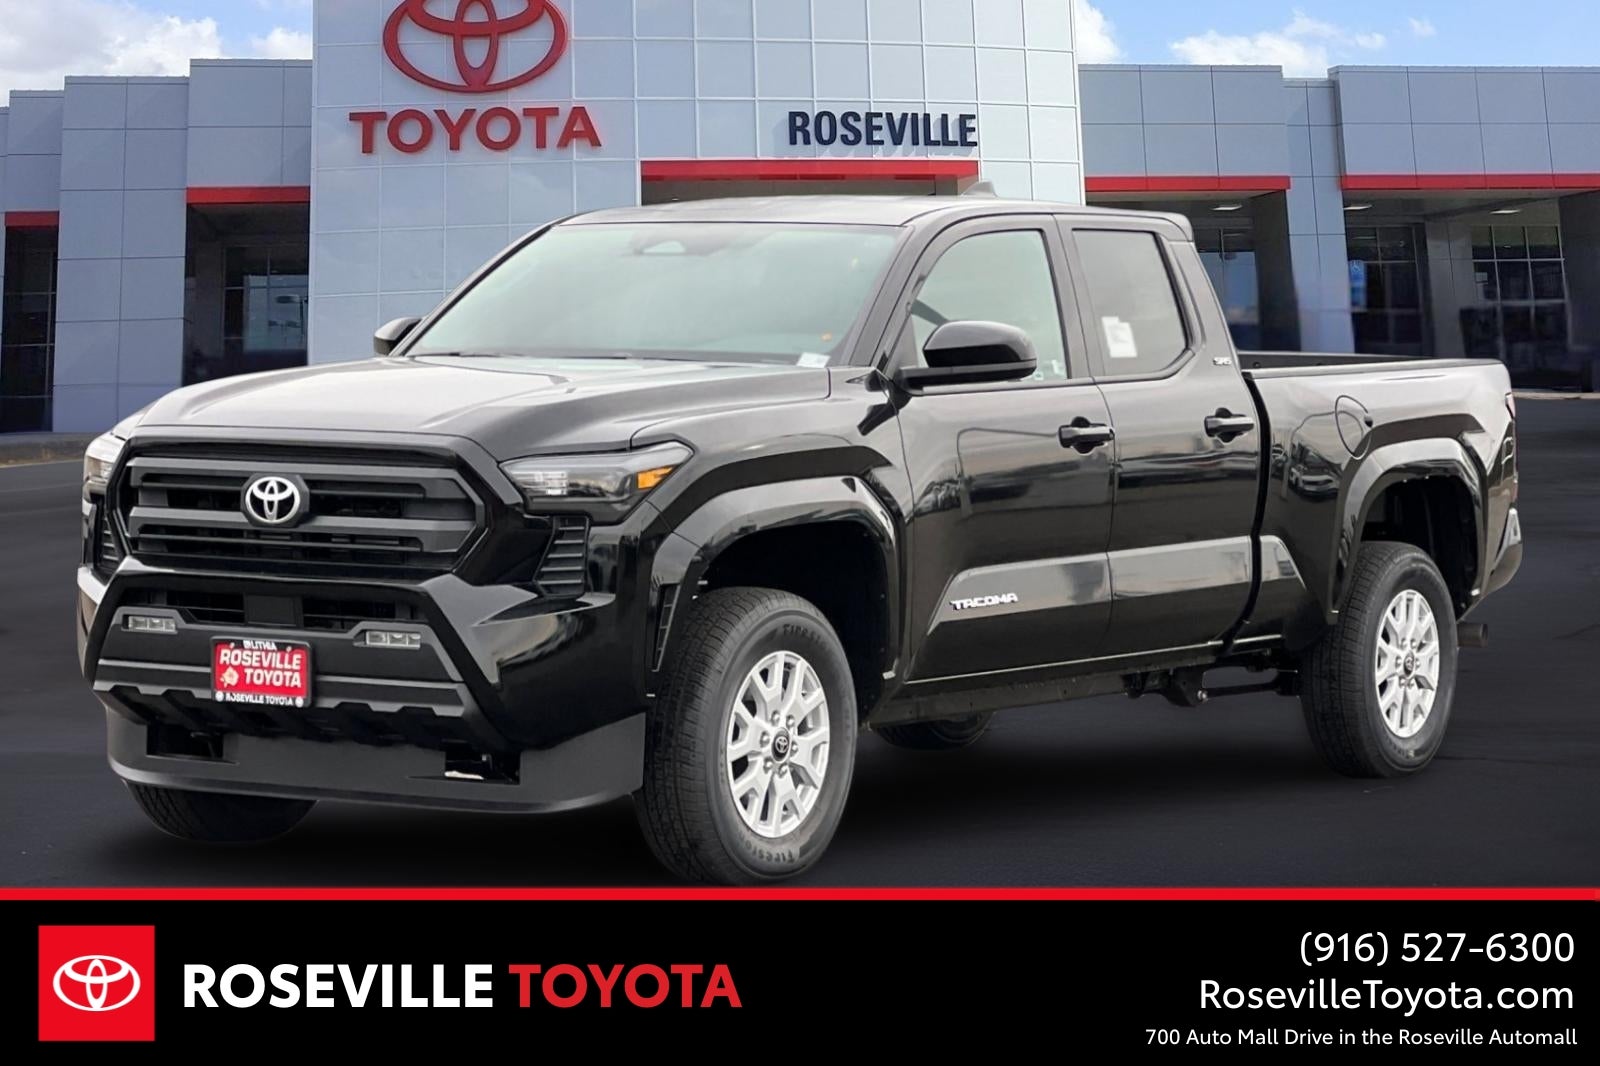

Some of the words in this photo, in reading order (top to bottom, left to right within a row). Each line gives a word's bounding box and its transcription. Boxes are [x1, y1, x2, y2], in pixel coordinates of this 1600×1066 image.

[349, 106, 602, 154] TOYOTA
[788, 110, 978, 147] ROSEVILLE
[950, 592, 1019, 610] TACOMA
[219, 649, 302, 670] ROSEVILLE
[244, 668, 302, 688] TOYOTA
